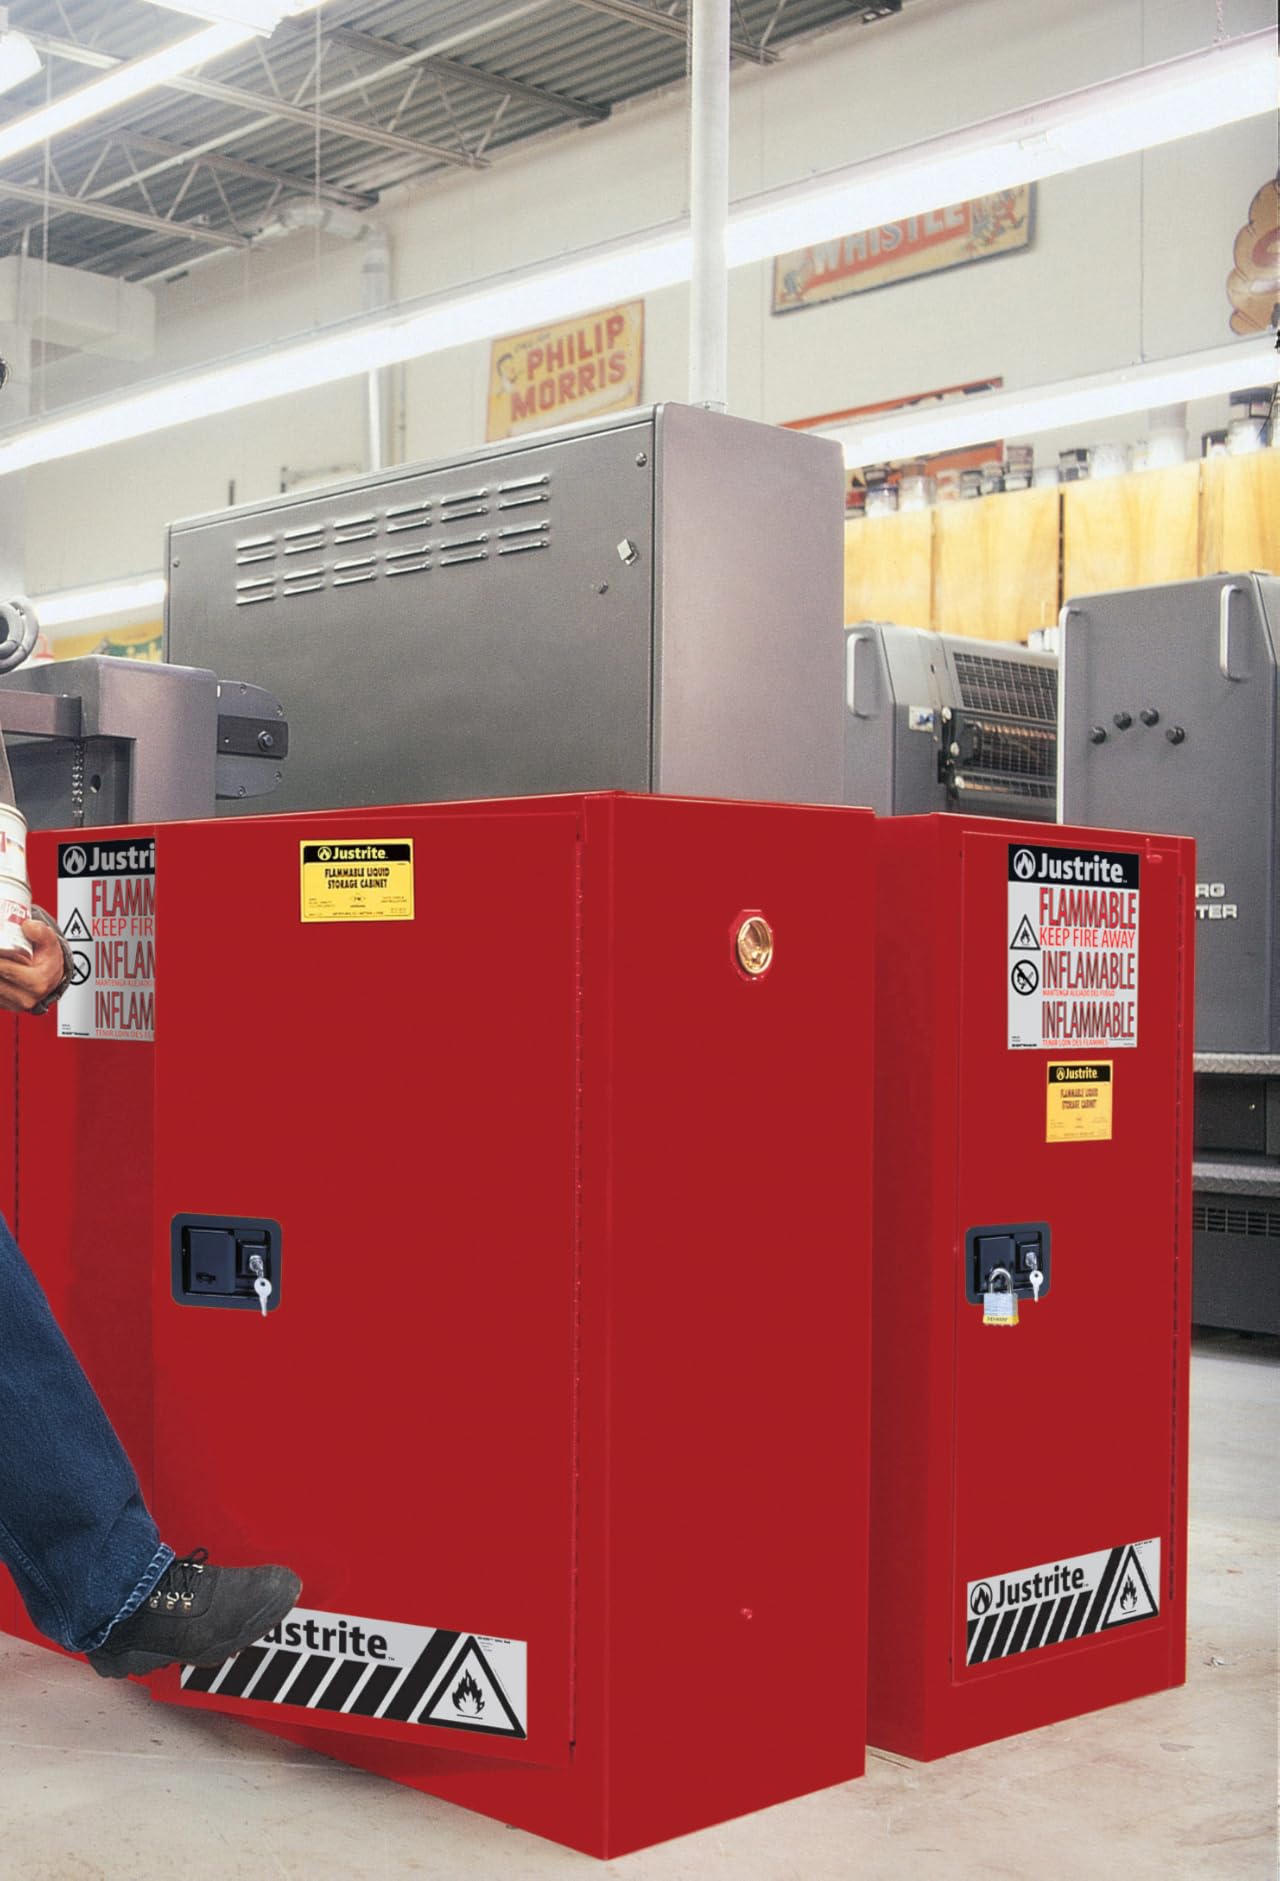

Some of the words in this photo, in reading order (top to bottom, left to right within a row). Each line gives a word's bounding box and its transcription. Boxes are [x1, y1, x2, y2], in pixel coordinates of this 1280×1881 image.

[526, 315, 625, 380] PHILIP
[511, 352, 626, 422] MORRIS
[89, 843, 155, 871] Justri
[332, 846, 386, 860] Justrite
[1038, 852, 1124, 883] Justrite
[324, 868, 365, 878] FLAMMABLE
[366, 867, 390, 877] LIQUID
[327, 879, 357, 889] STORAGE
[360, 879, 388, 888] CABINET
[1039, 886, 1136, 930] FLAMMABLE
[92, 917, 127, 936] KEEP
[130, 917, 153, 936] FIR
[1040, 927, 1070, 946] KEEP
[1073, 928, 1098, 947] FIRE
[1101, 930, 1136, 949] AWAY
[1042, 950, 1136, 990] INFLAMABLE
[1042, 1001, 1135, 1039] INFLAMMABLE
[1065, 1067, 1098, 1080] Justrite
[995, 1564, 1085, 1609] Justrite
